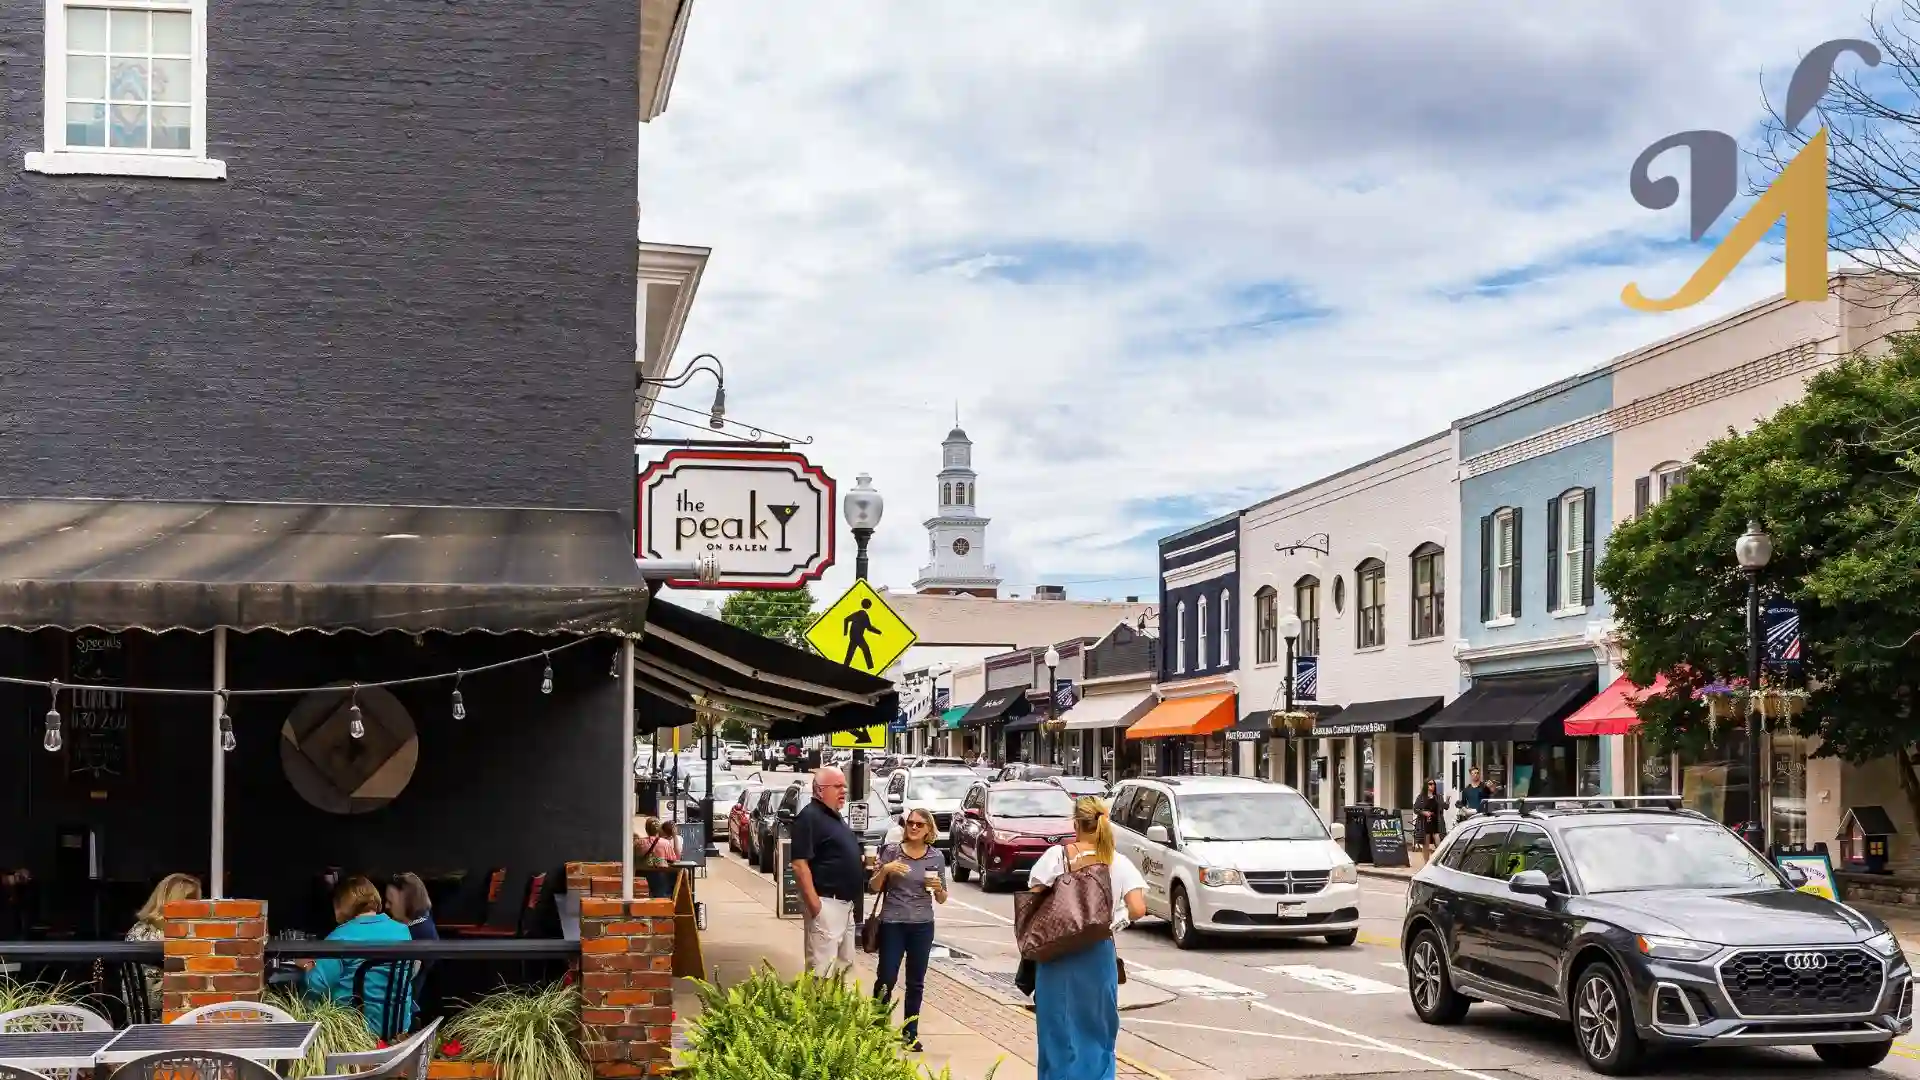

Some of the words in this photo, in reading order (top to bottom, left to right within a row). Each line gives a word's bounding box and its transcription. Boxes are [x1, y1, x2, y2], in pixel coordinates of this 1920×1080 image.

[676, 489, 705, 512] the
[675, 490, 769, 551] peak
[706, 543, 723, 551] ON
[729, 543, 768, 552] SALEM
[1351, 724, 1370, 733] KITCHEN
[1373, 723, 1387, 732] BATH
